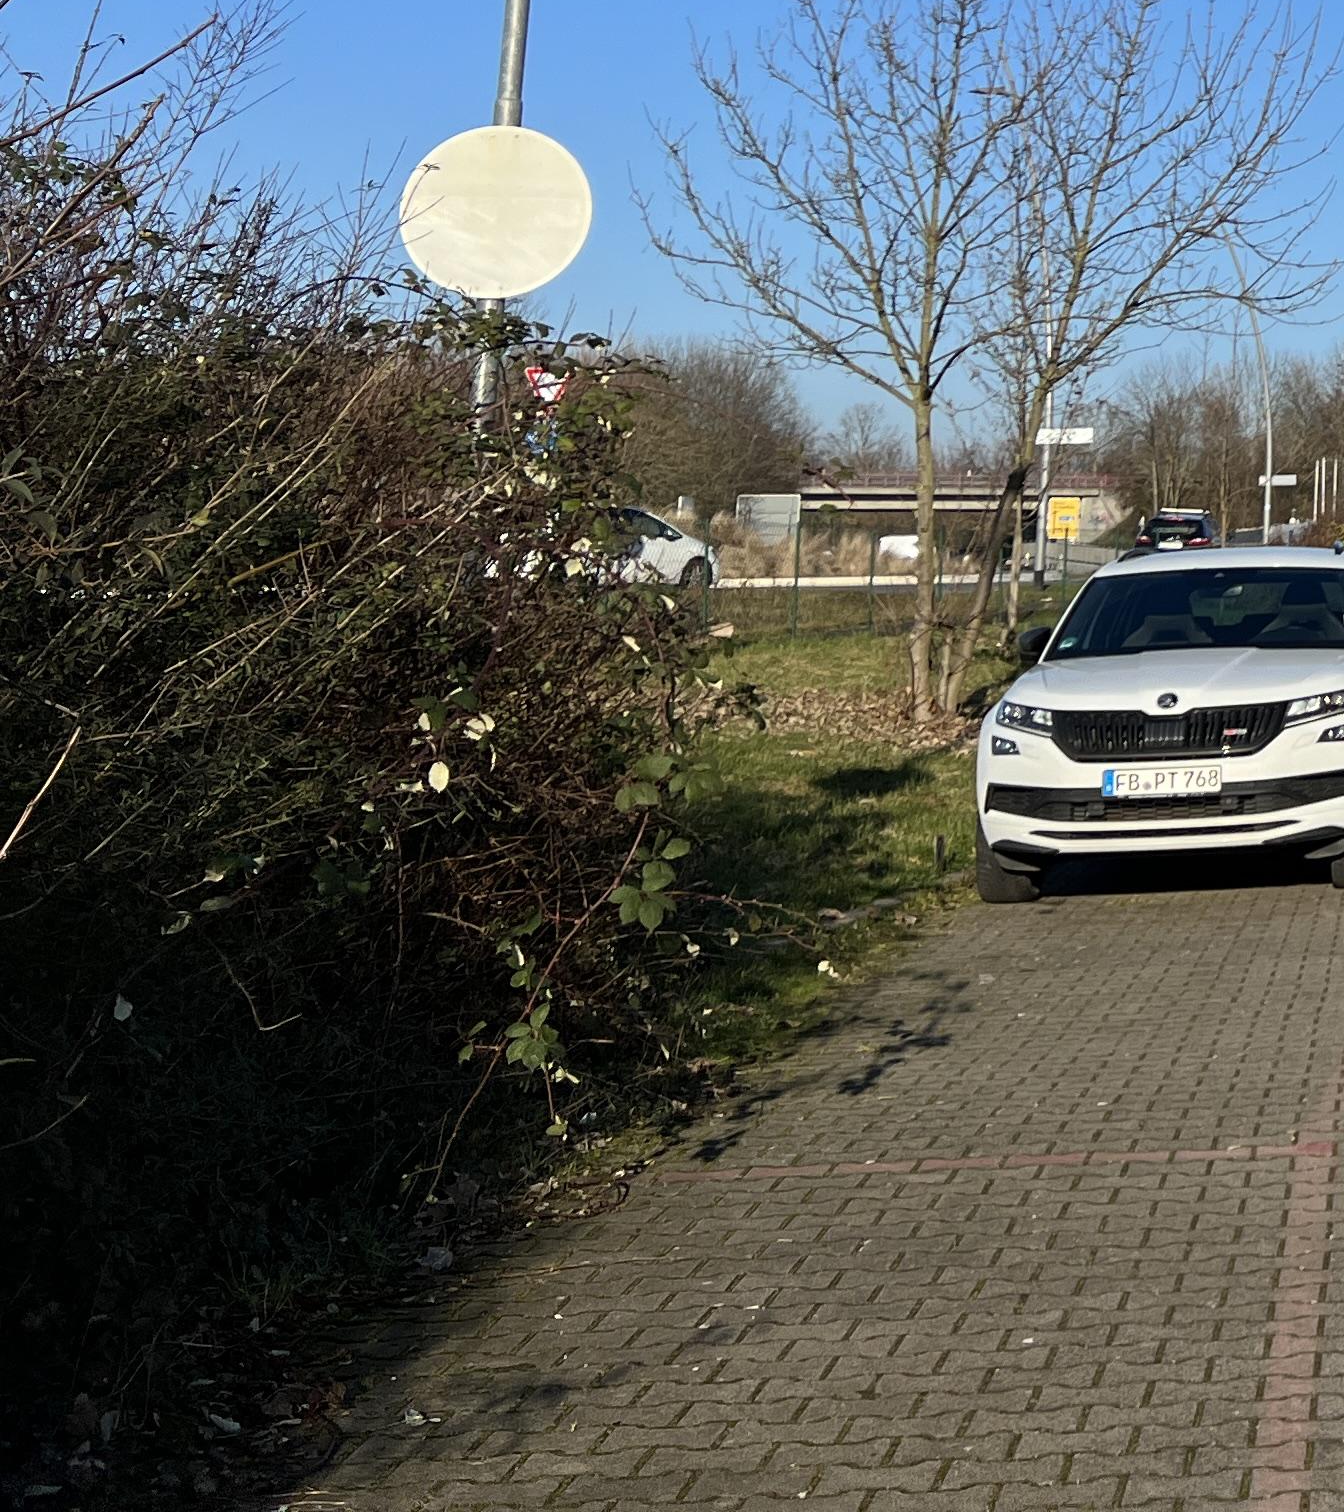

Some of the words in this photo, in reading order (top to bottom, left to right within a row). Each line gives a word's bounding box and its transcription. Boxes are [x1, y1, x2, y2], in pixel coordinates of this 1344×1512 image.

[1116, 773, 1140, 791] FB
[1154, 771, 1178, 790] PT
[1184, 769, 1218, 788] 768
